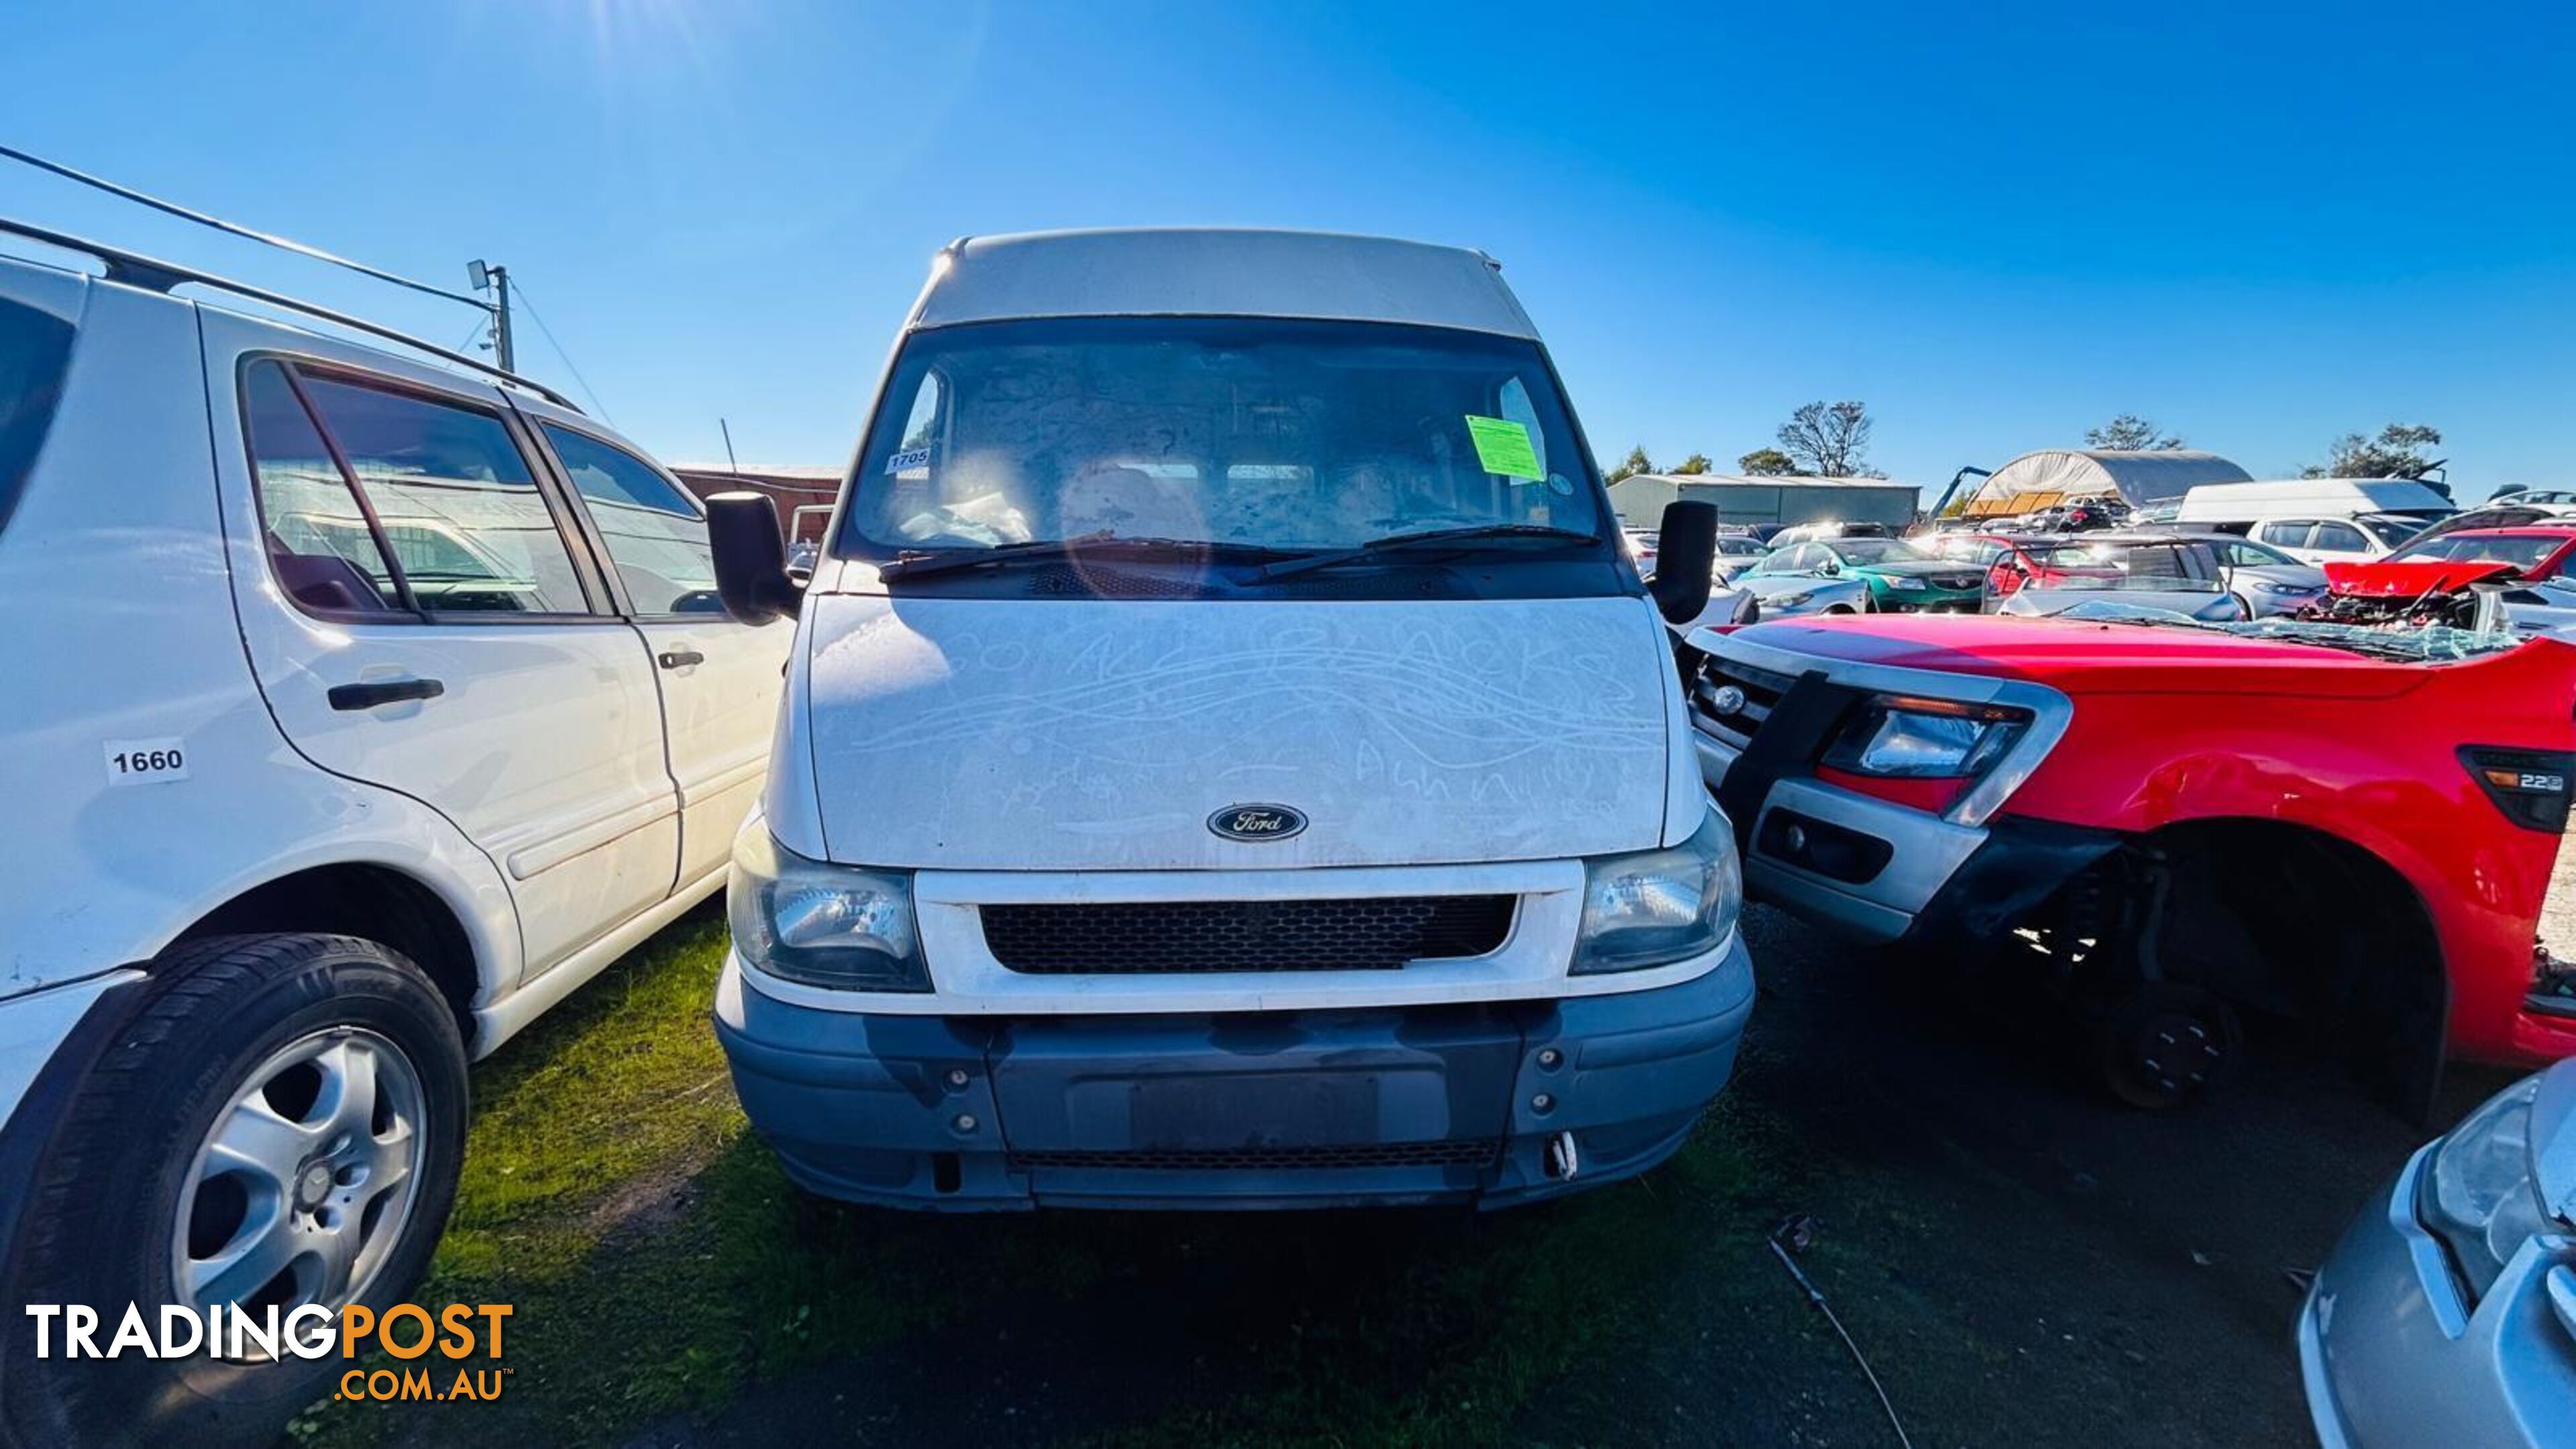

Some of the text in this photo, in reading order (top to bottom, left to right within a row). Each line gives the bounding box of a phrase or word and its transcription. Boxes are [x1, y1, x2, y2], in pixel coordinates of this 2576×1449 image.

[892, 451, 928, 467] 1705
[113, 750, 182, 773] 1660
[1233, 812, 1283, 831] Ford
